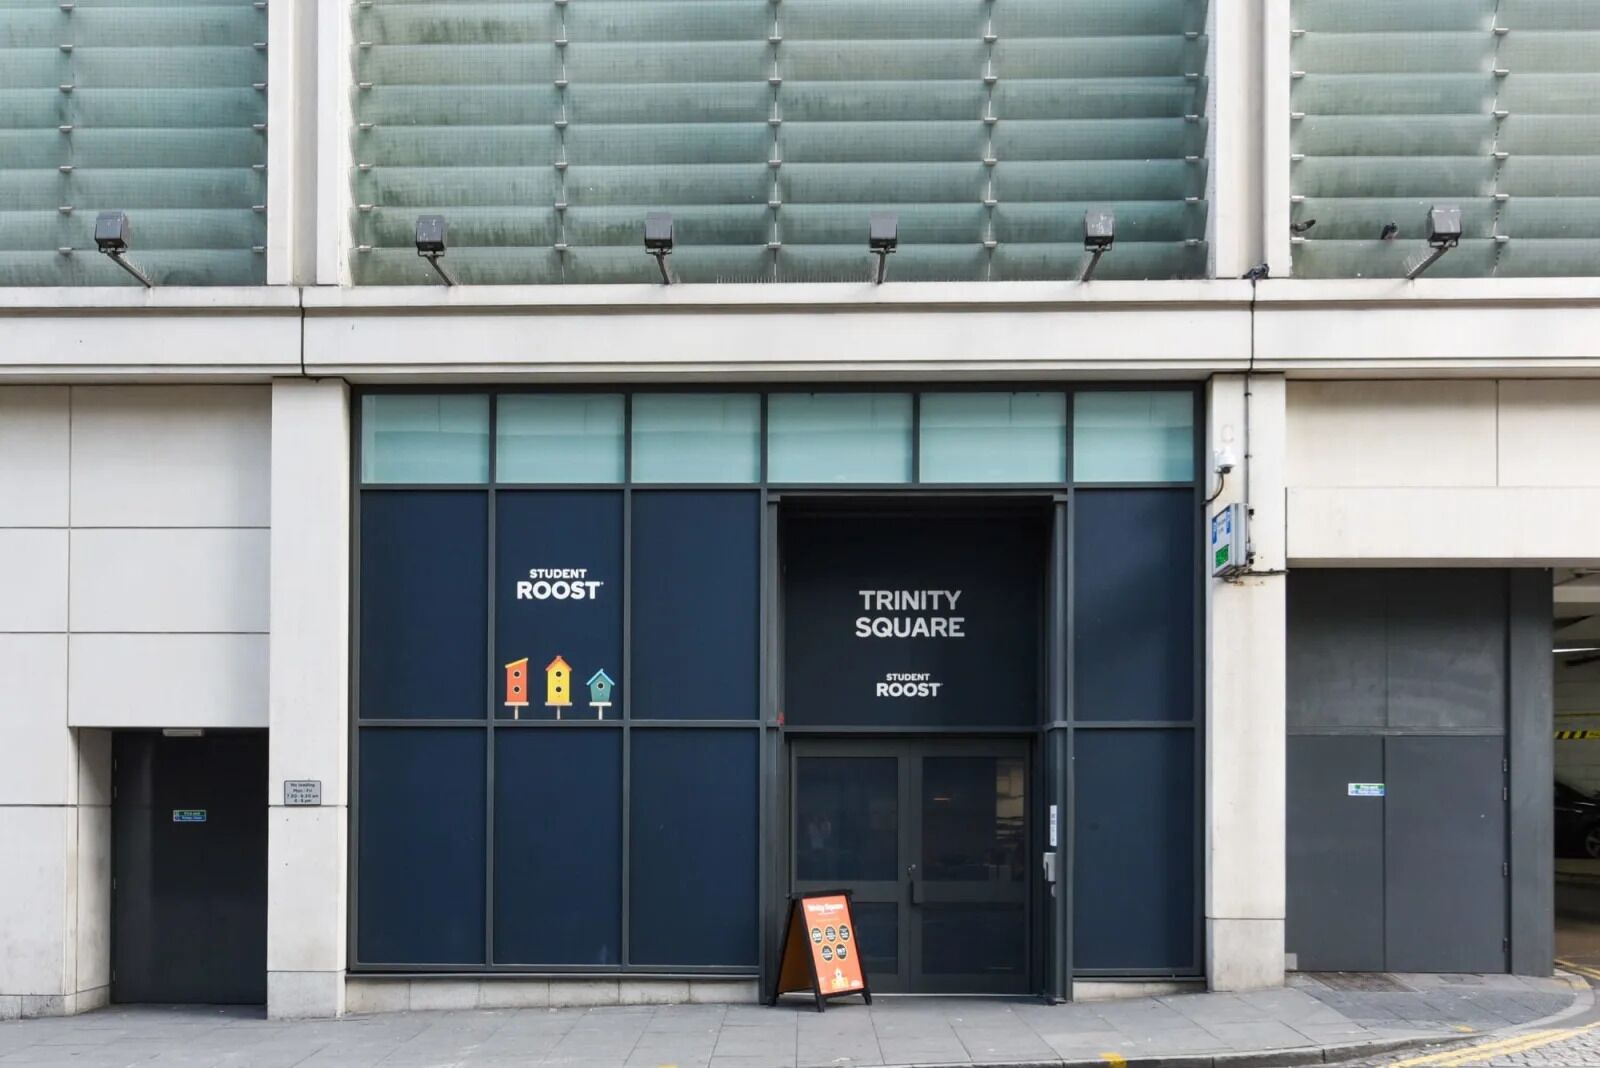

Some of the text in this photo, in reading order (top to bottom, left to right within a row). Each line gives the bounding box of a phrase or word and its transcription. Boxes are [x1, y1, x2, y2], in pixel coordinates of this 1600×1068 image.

[529, 568, 587, 579] STUDENT
[517, 580, 601, 600] ROOST
[859, 590, 962, 610] TRINITY
[855, 617, 965, 638] SQUARE
[886, 673, 931, 681] STUDENT
[876, 683, 941, 697] ROOST
